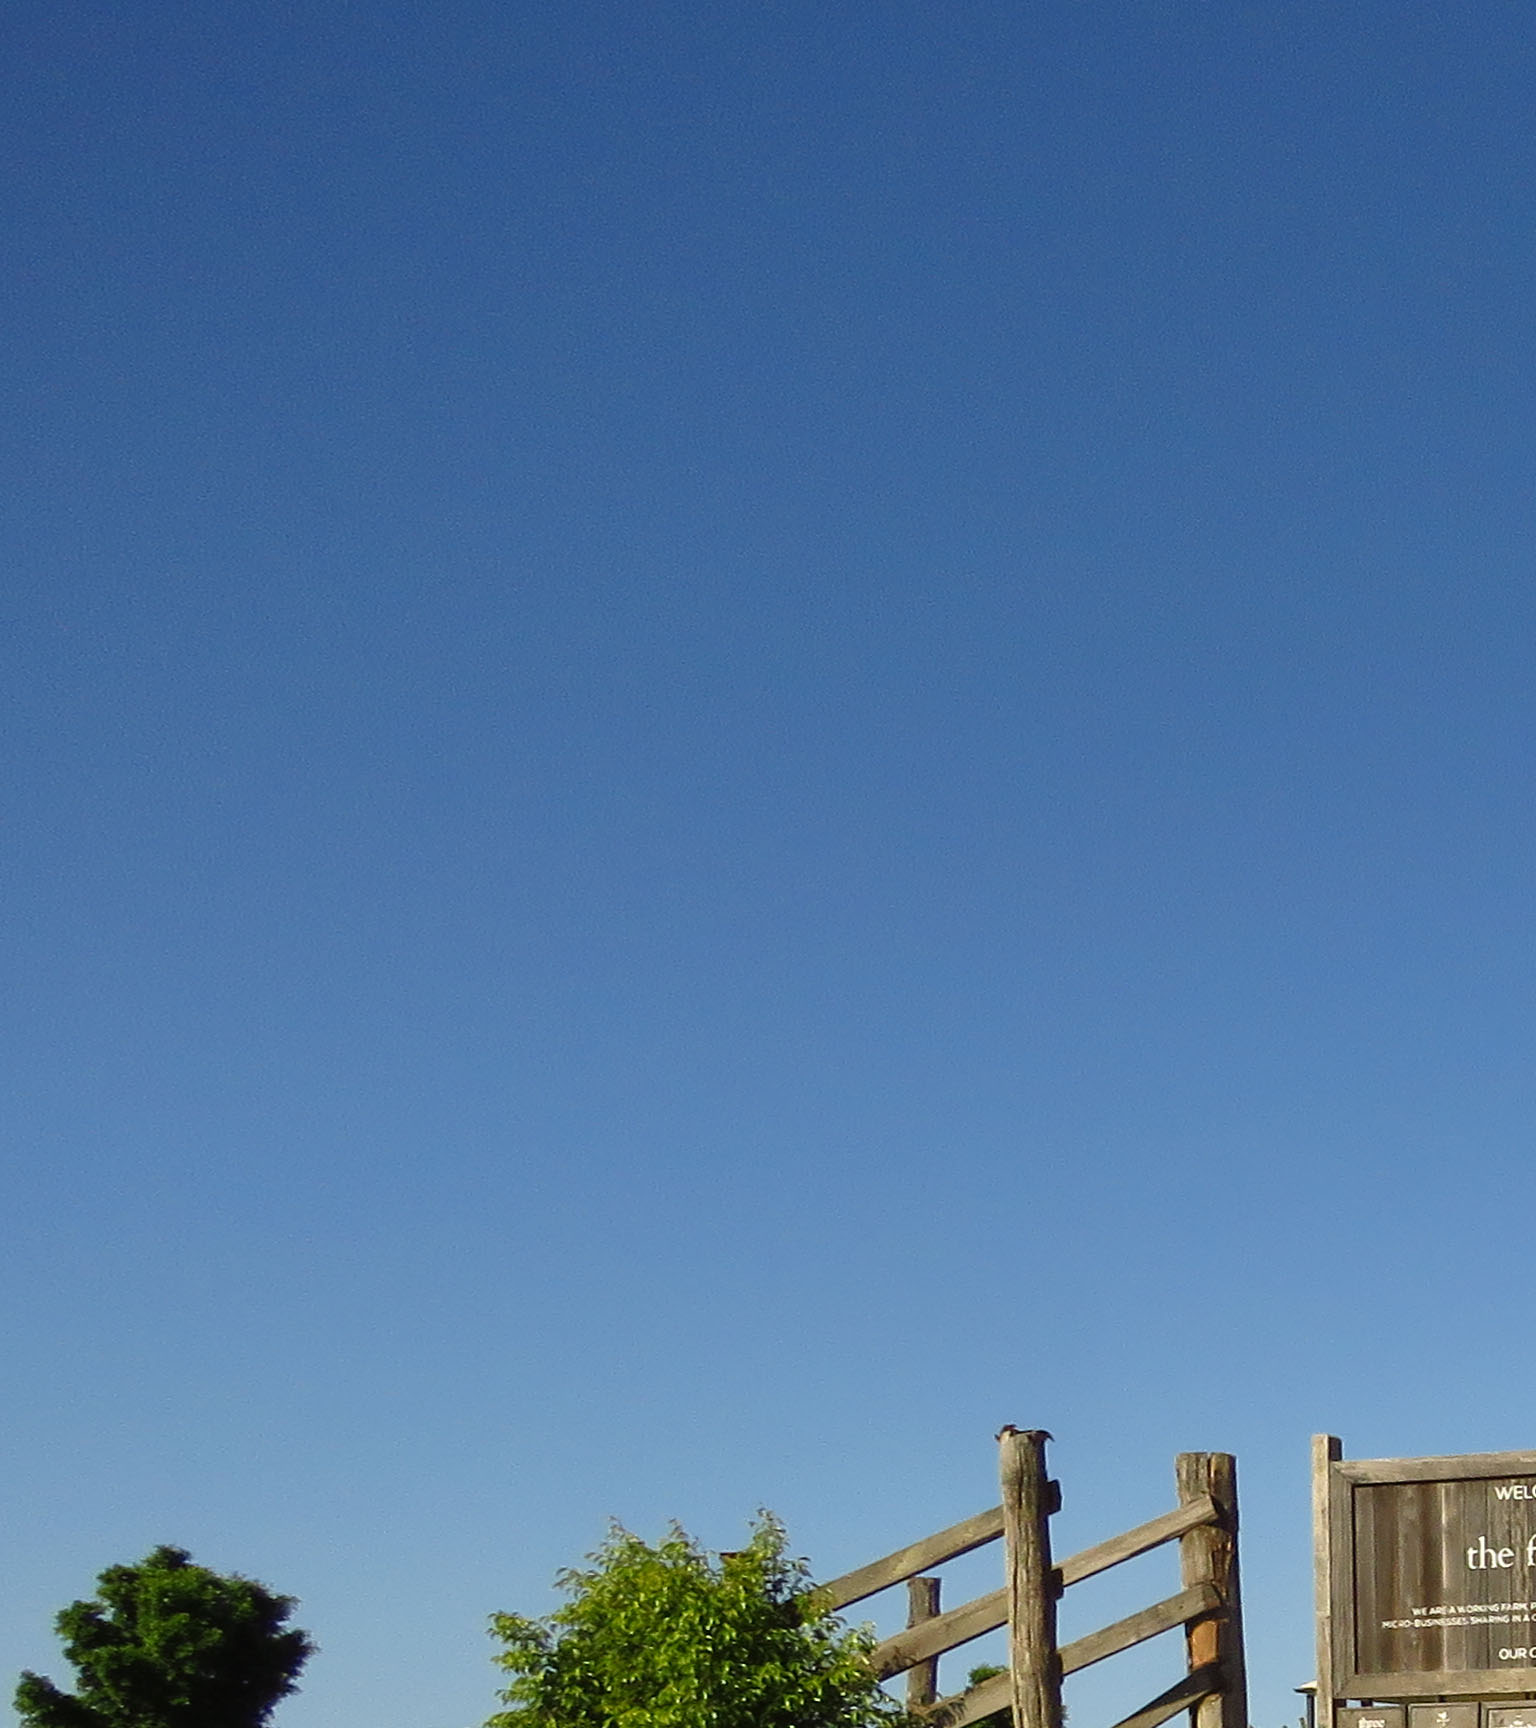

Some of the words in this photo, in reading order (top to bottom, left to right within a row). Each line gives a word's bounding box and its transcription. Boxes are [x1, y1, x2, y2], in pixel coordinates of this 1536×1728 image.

[1467, 1535, 1515, 1570] the
[1412, 1607, 1427, 1616] WE
[1429, 1606, 1447, 1615] ARE
[1511, 1614, 1522, 1623] IN
[1523, 1614, 1530, 1622] A
[1499, 1647, 1527, 1660] OUR
